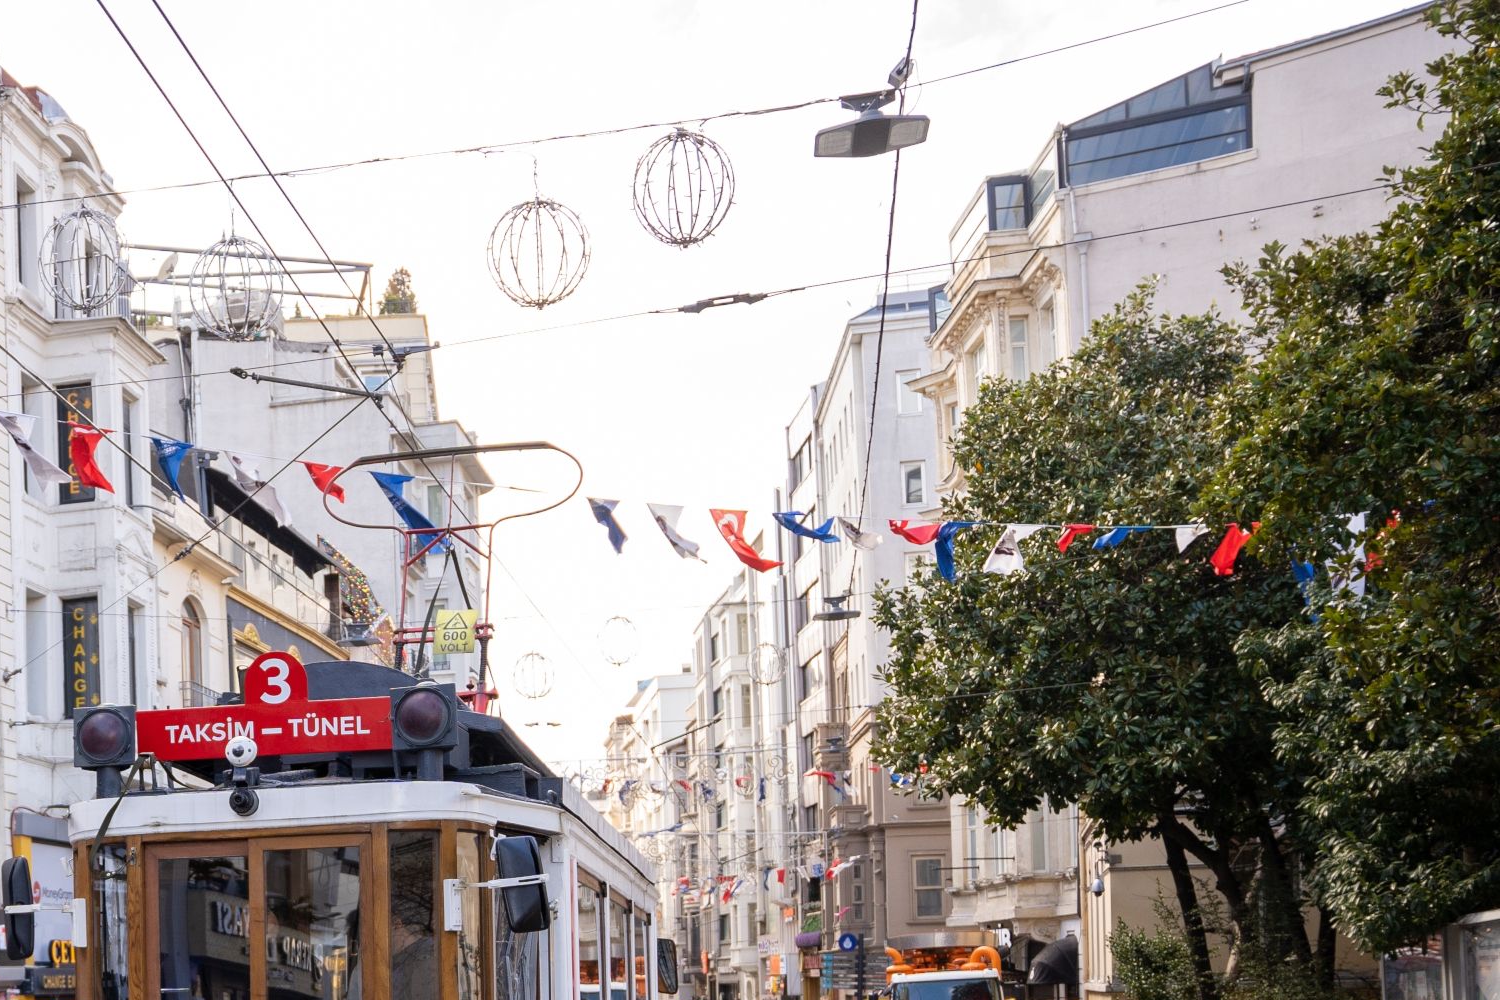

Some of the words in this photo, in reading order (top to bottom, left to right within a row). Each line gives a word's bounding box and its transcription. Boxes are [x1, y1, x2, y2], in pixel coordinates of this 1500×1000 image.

[443, 631, 467, 641] 600
[440, 643, 468, 652] VOLT
[260, 658, 292, 704] 3
[165, 716, 254, 744] TAKSİM
[288, 713, 370, 737] TÜNEL
